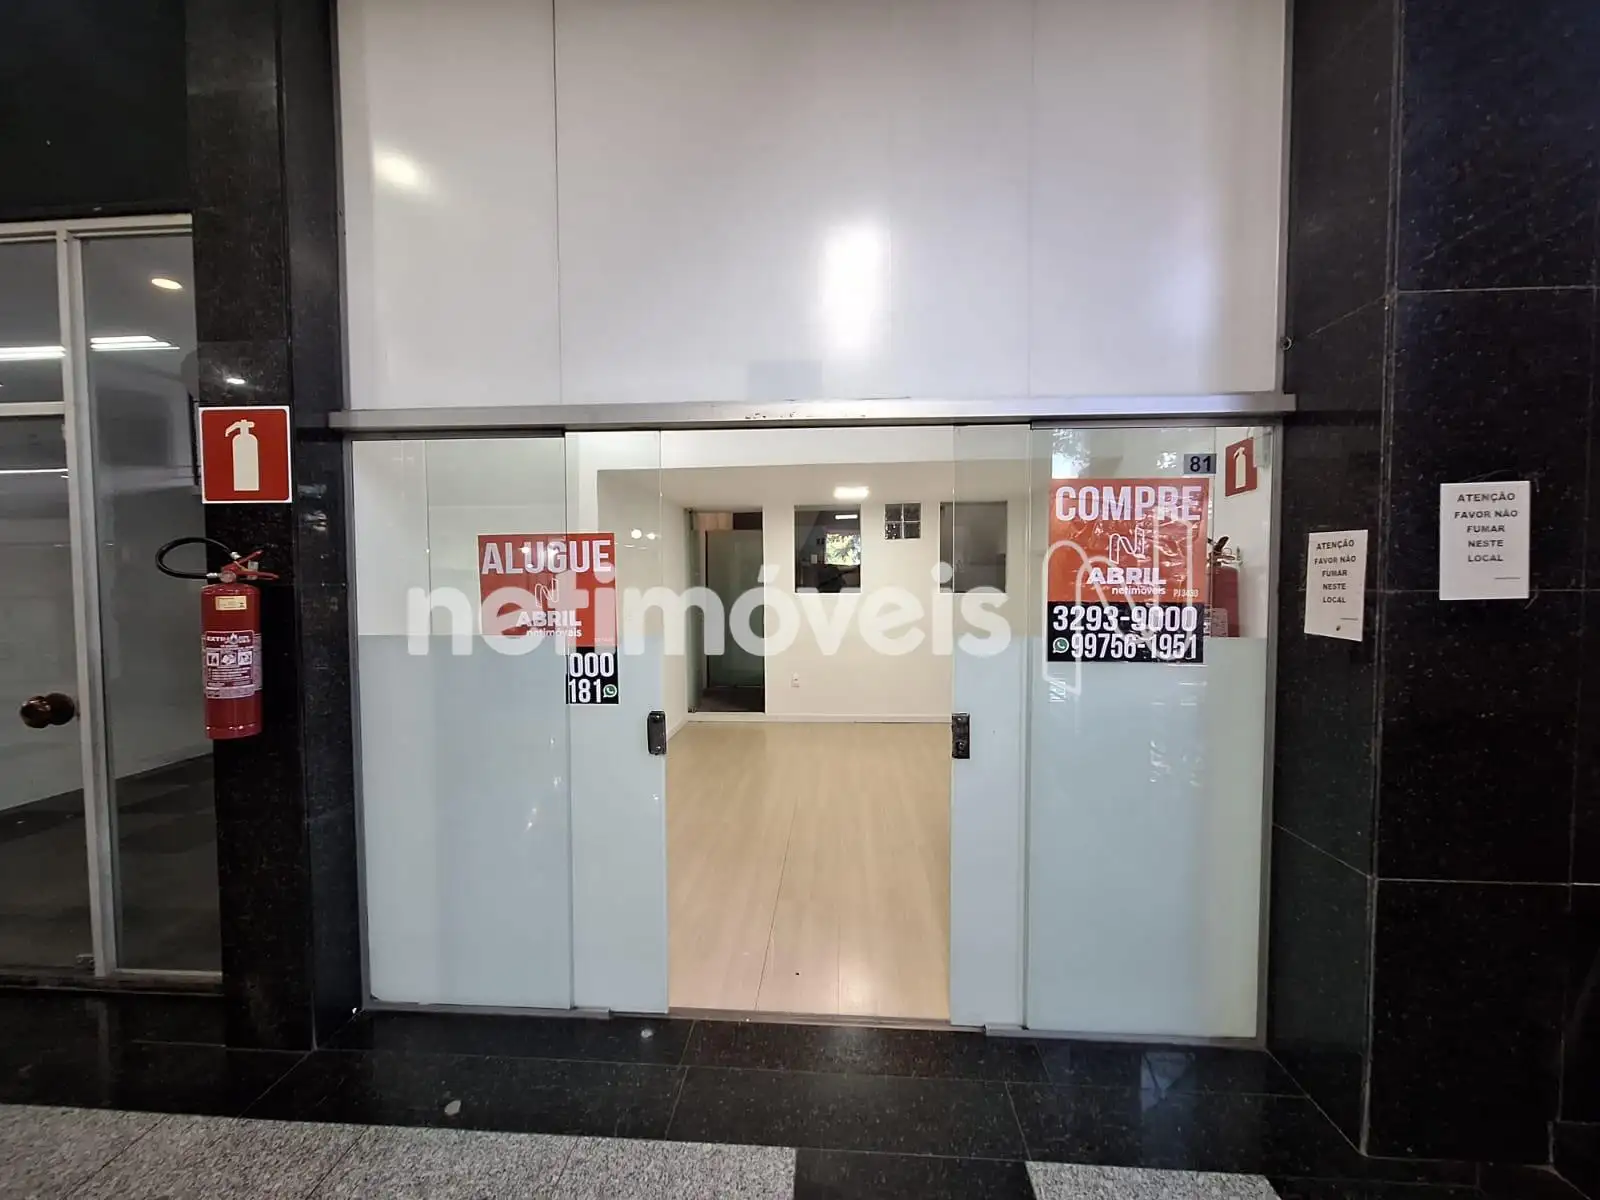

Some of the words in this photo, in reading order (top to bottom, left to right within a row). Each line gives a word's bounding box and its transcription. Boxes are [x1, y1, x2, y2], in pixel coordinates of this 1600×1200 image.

[1189, 455, 1212, 472] 81
[1055, 485, 1202, 521] COMPRE
[1457, 491, 1516, 503] ATENÇÃO
[1454, 510, 1492, 519] FAVOR
[1494, 509, 1518, 518] NÃO
[1467, 525, 1506, 533] FUMAR
[1316, 539, 1355, 551] ATENÇÃO
[1468, 540, 1504, 548] NESTE
[481, 540, 612, 575] ALUGUE
[1086, 567, 1167, 585] ABRIL
[515, 610, 582, 627] ABRIL
[1052, 605, 1198, 632] 3293-9000
[1071, 633, 1197, 659] 99756-1951
